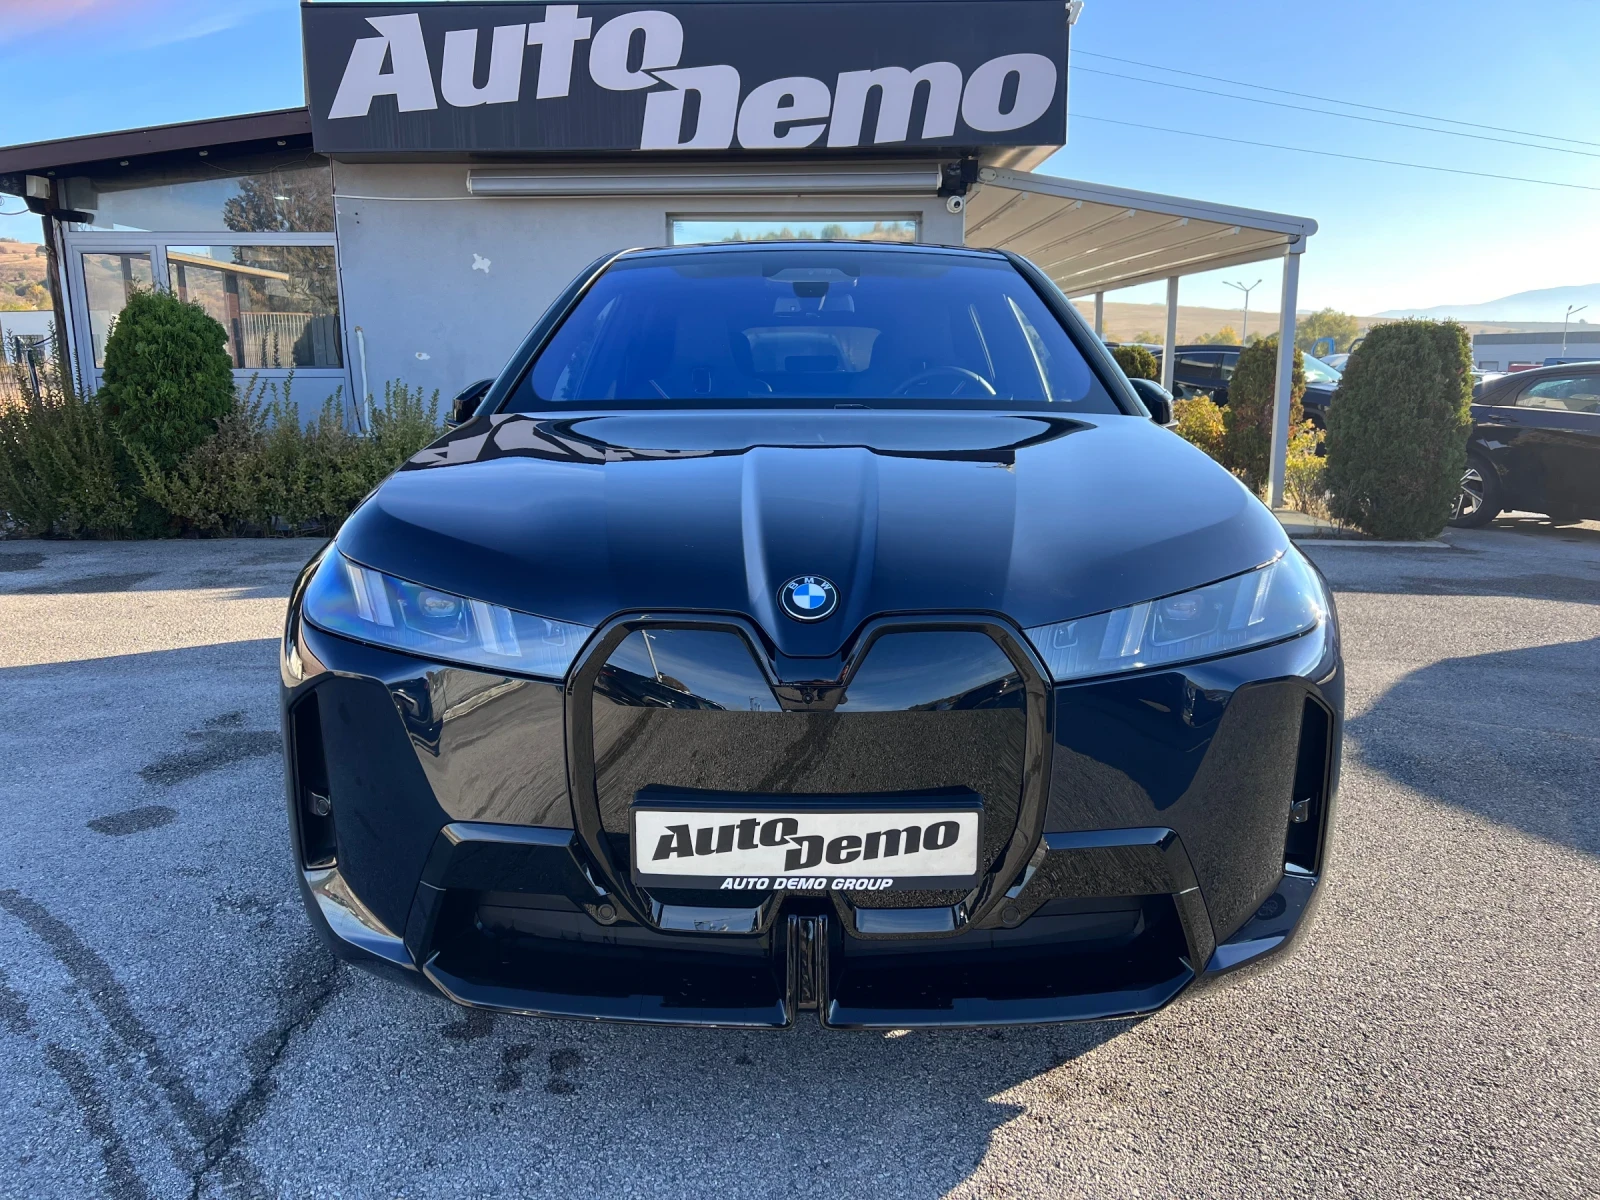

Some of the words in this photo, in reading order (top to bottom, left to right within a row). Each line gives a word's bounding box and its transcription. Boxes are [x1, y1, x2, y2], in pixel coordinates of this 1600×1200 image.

[328, 4, 684, 119] Auto
[640, 52, 1058, 150] Demo
[788, 577, 832, 590] BMW
[652, 817, 799, 861] Auto
[784, 820, 960, 872] Demo
[720, 877, 769, 890] AUTO
[773, 877, 827, 890] DEMO
[831, 878, 893, 890] GROUP
